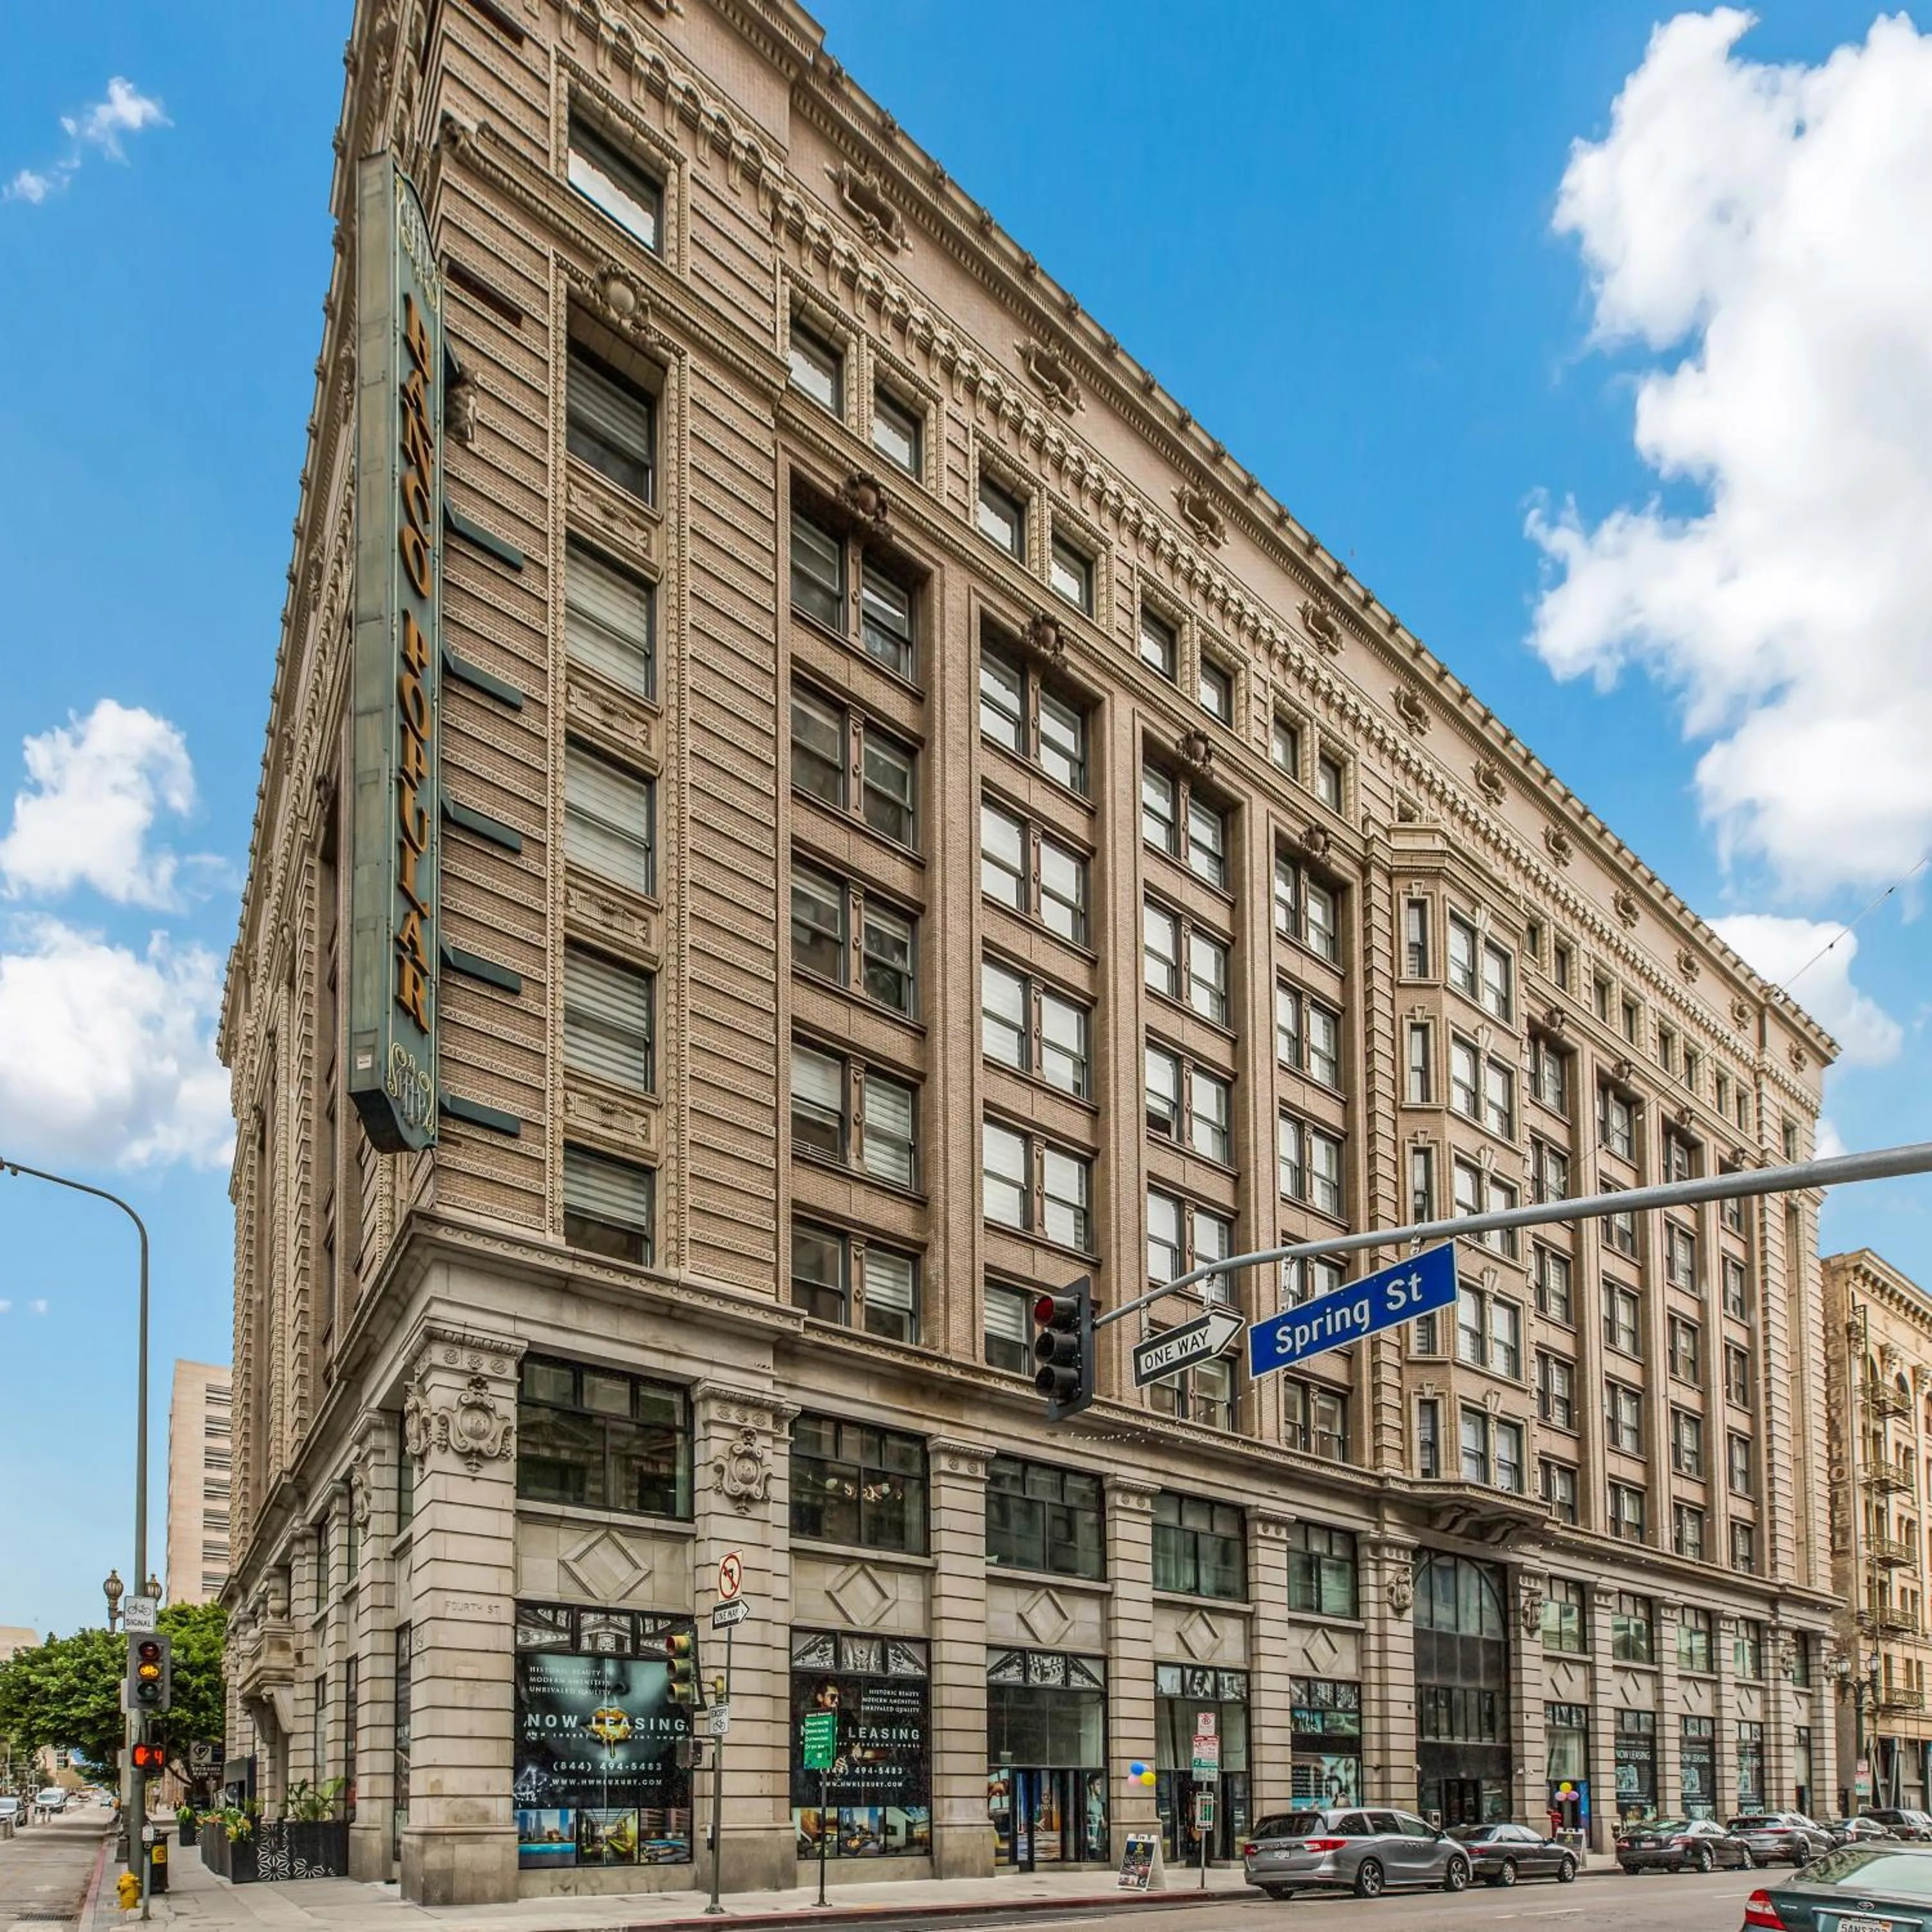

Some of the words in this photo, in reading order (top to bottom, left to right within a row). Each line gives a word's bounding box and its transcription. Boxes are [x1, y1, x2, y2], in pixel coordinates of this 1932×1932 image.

[400, 292, 433, 599] BANCO
[396, 608, 431, 1034] POPULAR
[1276, 1299, 1370, 1355] Spring
[1387, 1272, 1423, 1311] St
[1144, 1345, 1173, 1370] ONE
[1178, 1329, 1208, 1356] WAY
[445, 1600, 482, 1612] FOURTH
[488, 1605, 500, 1615] ST
[126, 1618, 152, 1627] SIGNAL
[527, 1714, 578, 1728] NOW
[591, 1716, 687, 1731] LEASING
[848, 1727, 920, 1739] LEASING
[1629, 1750, 1651, 1760] LEASING
[553, 1761, 592, 1772] (844)
